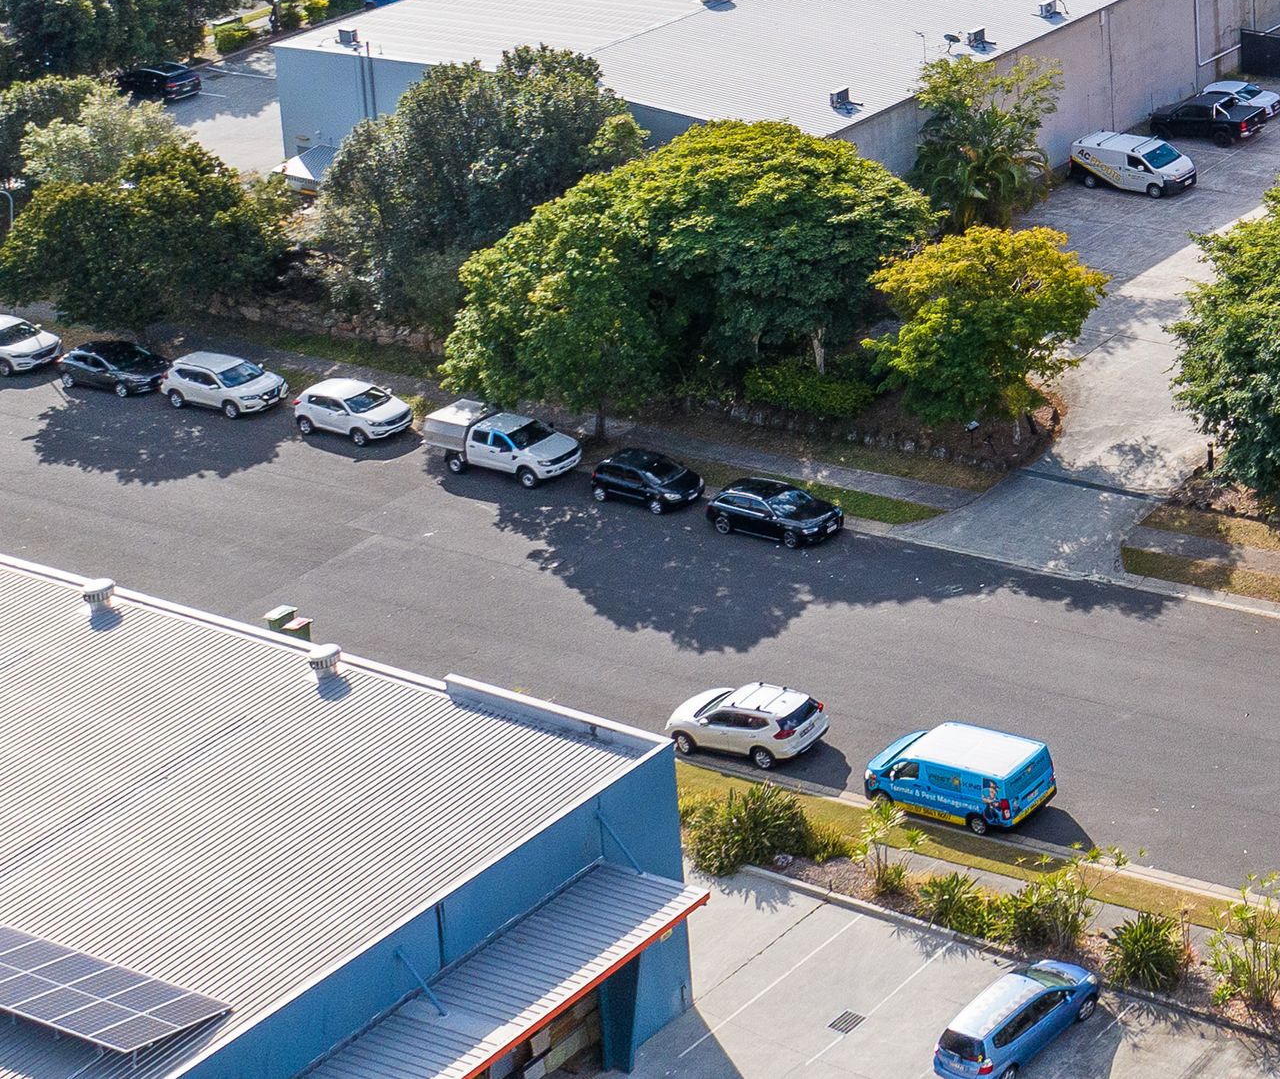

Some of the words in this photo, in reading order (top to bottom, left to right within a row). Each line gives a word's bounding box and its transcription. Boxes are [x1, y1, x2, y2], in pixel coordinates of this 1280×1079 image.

[1077, 148, 1091, 161] AC
[890, 784, 914, 796] Termite
[914, 789, 921, 797] &
[921, 791, 937, 801] Pest
[937, 794, 979, 811] Management
